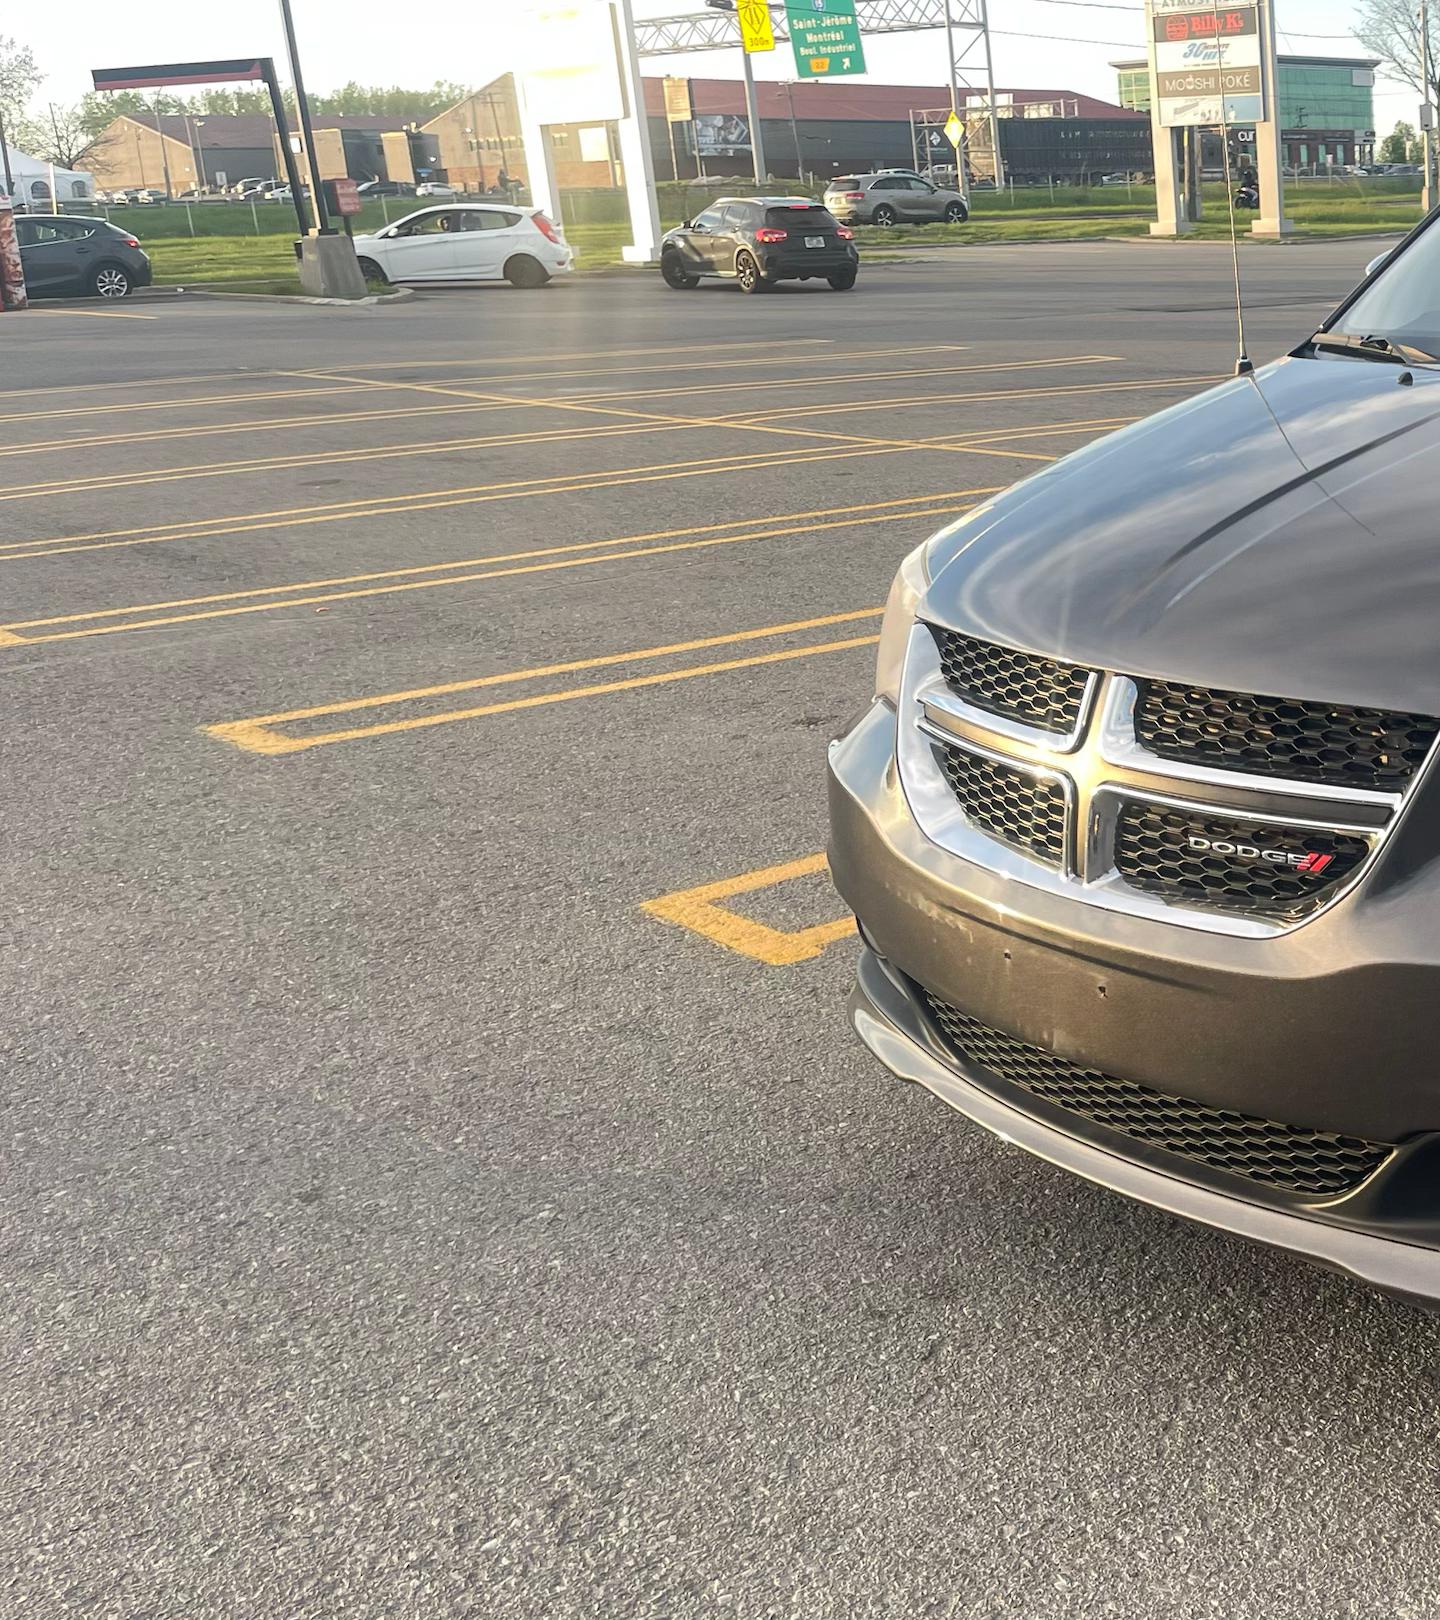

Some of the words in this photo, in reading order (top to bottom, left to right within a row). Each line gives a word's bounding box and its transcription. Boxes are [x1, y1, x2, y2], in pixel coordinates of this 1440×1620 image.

[793, 15, 852, 29] Saint-Jérôme
[1190, 16, 1224, 32] Billy
[806, 30, 844, 43] Montréal
[800, 47, 818, 56] Boul.
[820, 43, 856, 53] Industriel
[1188, 835, 1311, 867] DODGE
